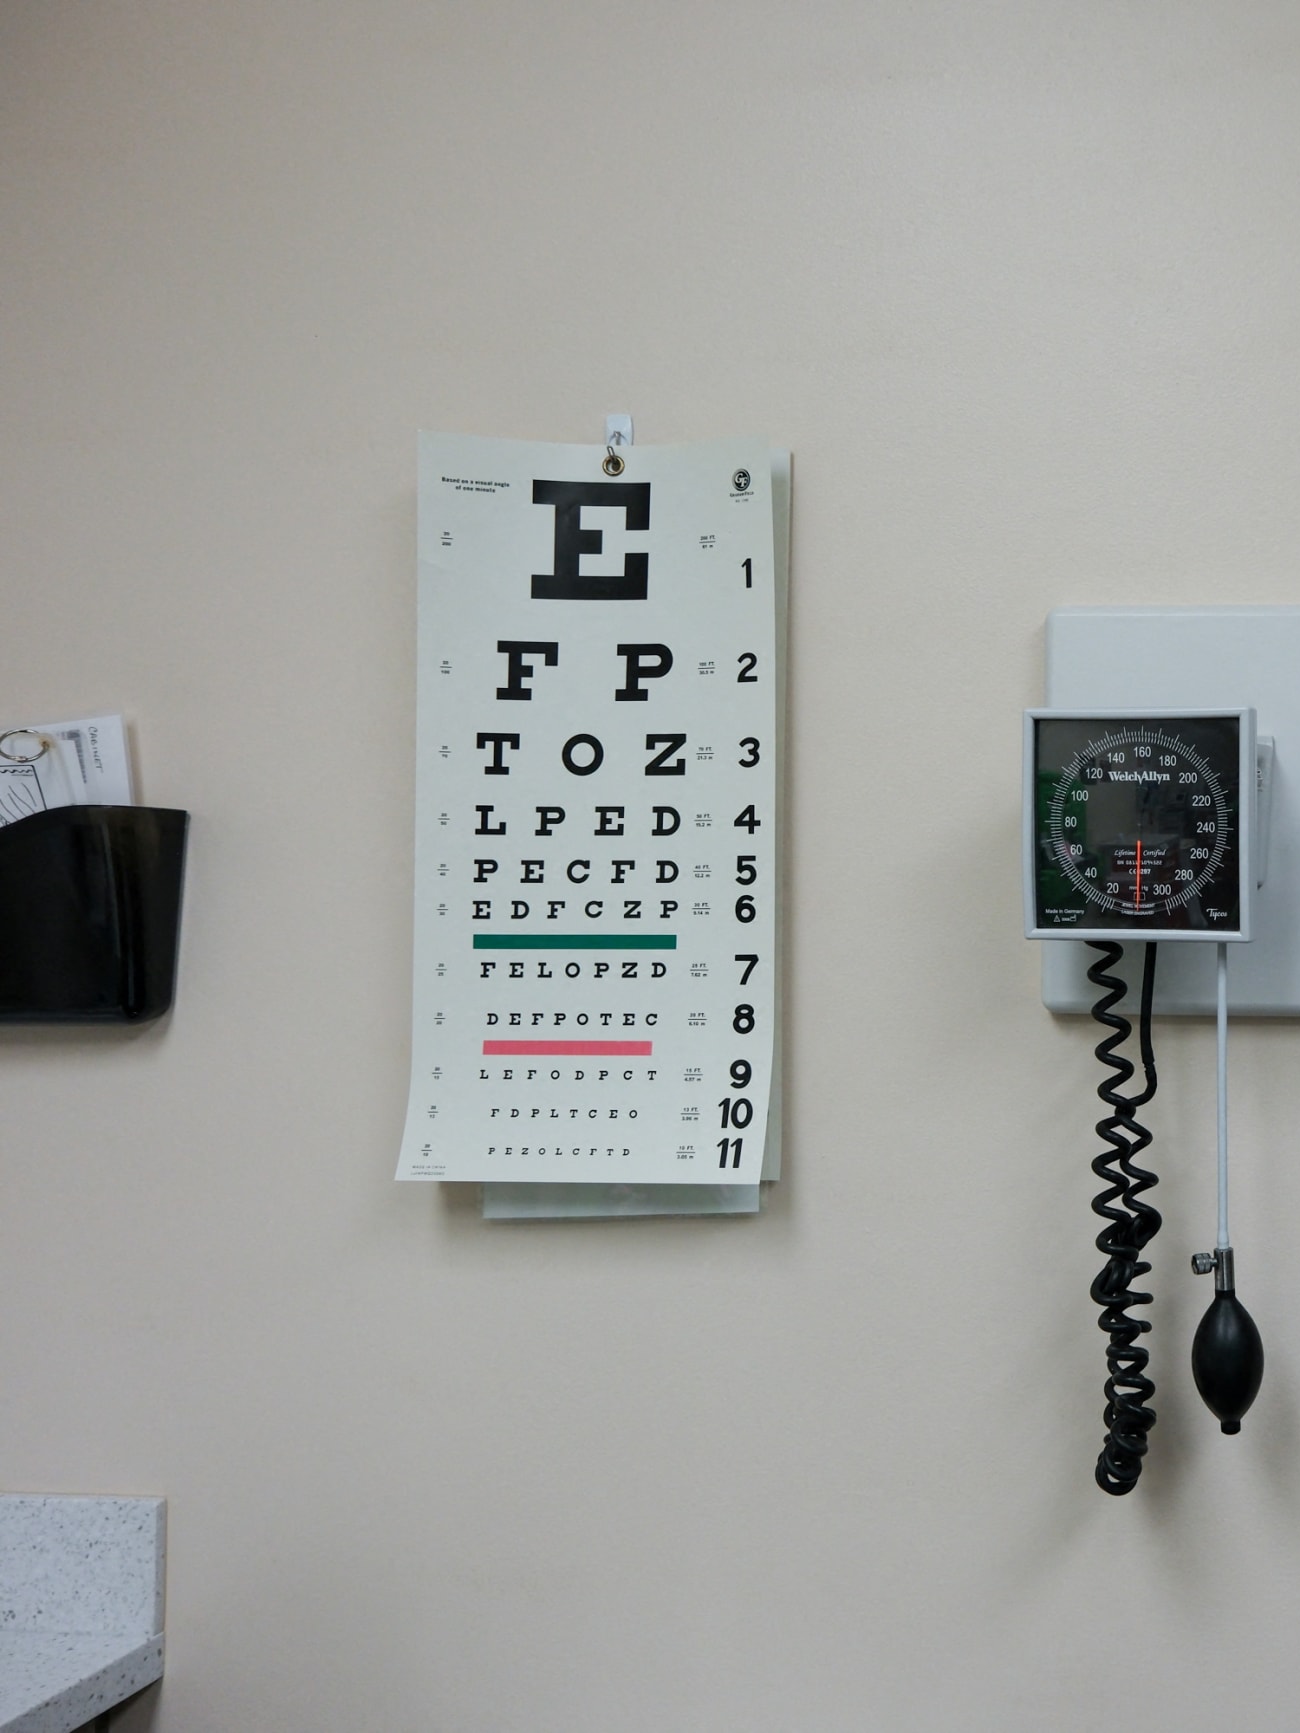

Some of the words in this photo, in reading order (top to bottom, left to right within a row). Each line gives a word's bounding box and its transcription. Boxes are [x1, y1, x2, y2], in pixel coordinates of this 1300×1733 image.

[531, 479, 651, 600] E
[742, 558, 752, 588] 1
[496, 640, 558, 700] F
[615, 644, 673, 701] P
[737, 653, 757, 682] 2
[477, 733, 520, 775] T
[562, 734, 604, 776] O
[645, 734, 686, 776] Z
[739, 737, 760, 768] 3
[1107, 752, 1124, 764] 140
[1134, 747, 1151, 758] 160
[1159, 755, 1176, 766] 180
[1086, 768, 1103, 779] 120
[1108, 771, 1170, 785] WelchAllyn
[1179, 773, 1197, 784] 200
[1072, 790, 1088, 801] 100
[1192, 795, 1210, 806] 220
[475, 805, 506, 835] L
[535, 807, 565, 836] P
[594, 806, 624, 836] E
[652, 806, 680, 836] D
[734, 805, 761, 834] 4
[1065, 817, 1077, 828] 80
[1197, 822, 1215, 833] 240
[1070, 845, 1082, 856] 60
[1114, 849, 1136, 857] Lifetime
[1143, 849, 1166, 857] Certified
[1190, 848, 1208, 860] 260
[474, 859, 498, 882] P
[520, 860, 544, 883] E
[567, 860, 590, 883] C
[611, 860, 635, 883] F
[656, 861, 679, 883] D
[736, 856, 757, 885] 5
[1085, 867, 1097, 878] 40
[1175, 870, 1193, 880] 280
[1106, 883, 1119, 894] 20
[1153, 884, 1172, 896] 300
[472, 901, 491, 919] E
[511, 901, 529, 919] D
[547, 901, 565, 919] F
[585, 901, 603, 918] C
[624, 901, 641, 918] Z
[660, 901, 678, 918] P
[735, 895, 756, 923] 6
[480, 962, 496, 978] F
[509, 963, 524, 978] E
[538, 963, 552, 978] L
[565, 963, 580, 978] O
[594, 963, 609, 978] P
[622, 963, 638, 978] Z
[651, 963, 666, 977] D
[735, 954, 759, 985] 7
[487, 1013, 498, 1025] D
[509, 1013, 521, 1025] E
[532, 1013, 543, 1025] F
[554, 1013, 566, 1025] P
[577, 1013, 588, 1025] O
[600, 1013, 612, 1025] T
[623, 1014, 635, 1025] E
[646, 1014, 657, 1025] C
[733, 1004, 755, 1034] 8
[480, 1070, 488, 1079] L
[503, 1070, 512, 1079] E
[528, 1070, 536, 1079] F
[551, 1070, 560, 1079] O
[575, 1071, 584, 1080] D
[599, 1071, 608, 1080] P
[624, 1071, 632, 1080] C
[648, 1071, 656, 1080] T
[730, 1060, 752, 1089] 9
[491, 1109, 499, 1117] F
[511, 1109, 519, 1117] D
[531, 1109, 539, 1117] P
[550, 1109, 558, 1117] L
[570, 1110, 578, 1118] T
[589, 1110, 597, 1118] C
[609, 1110, 618, 1118] E
[629, 1110, 637, 1118] O
[718, 1098, 753, 1129] 10
[717, 1138, 743, 1168] 11
